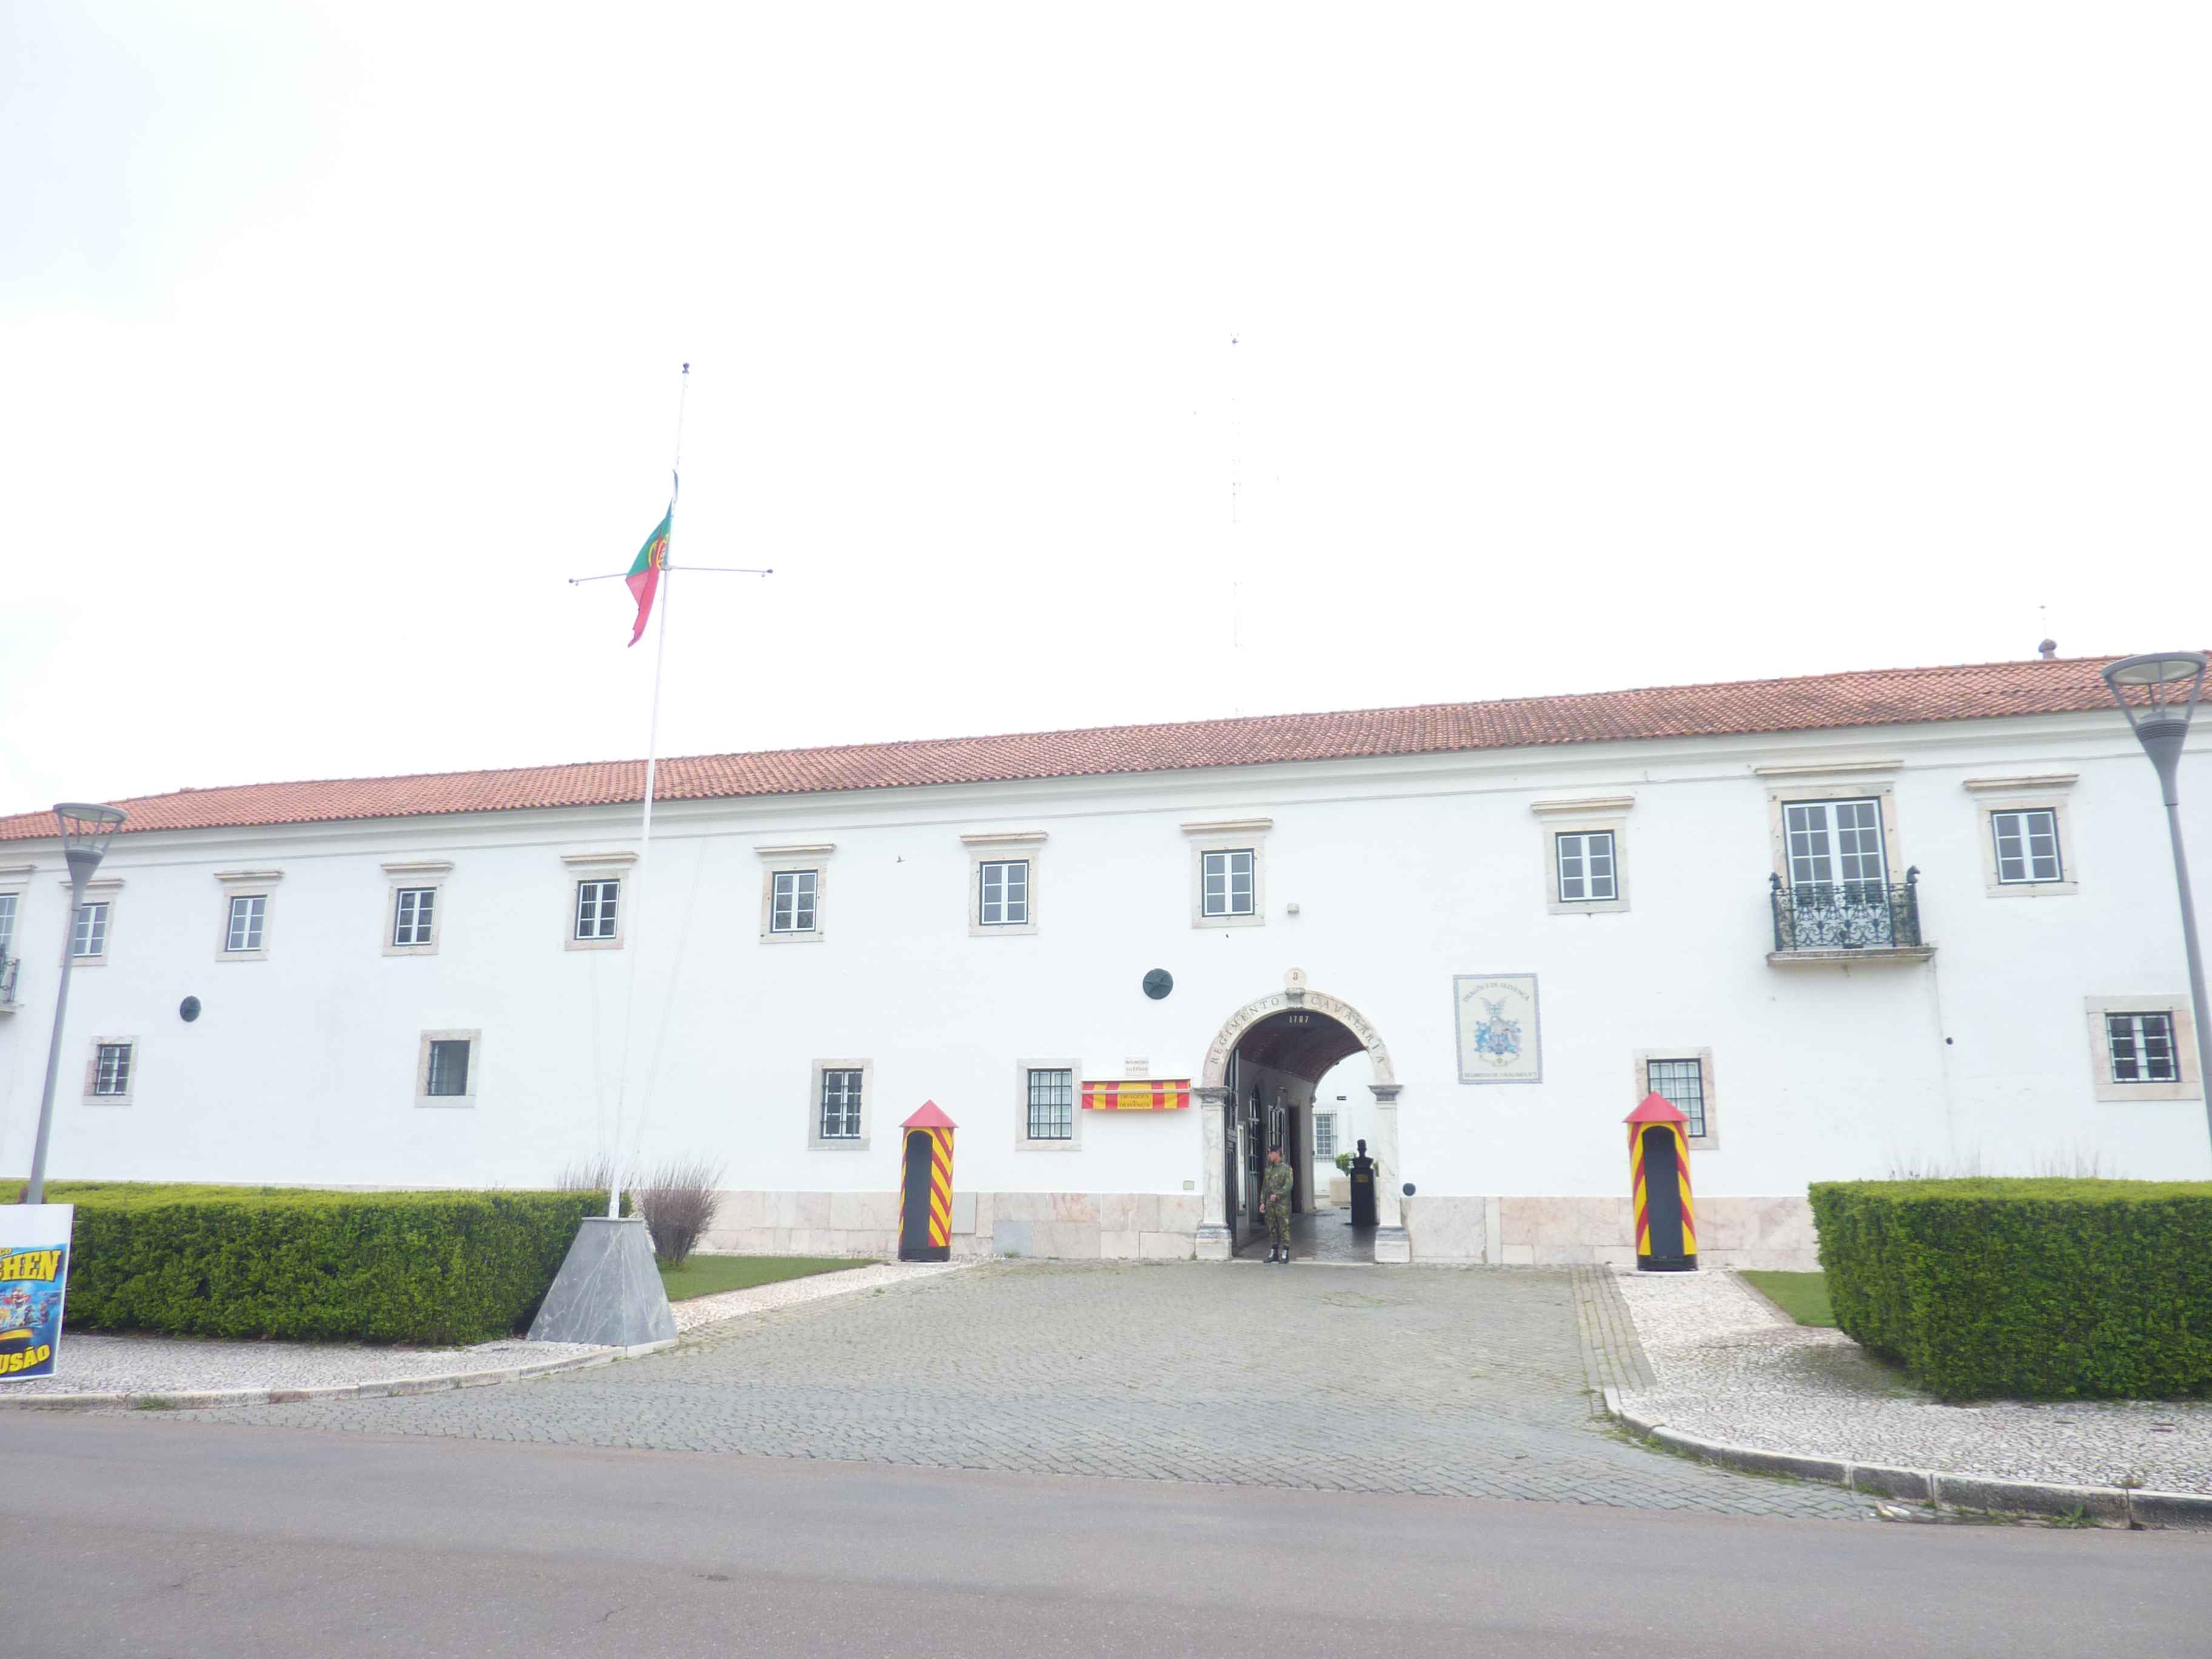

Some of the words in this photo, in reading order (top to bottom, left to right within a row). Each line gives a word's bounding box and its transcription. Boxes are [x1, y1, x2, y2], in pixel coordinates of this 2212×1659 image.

[1292, 971, 1299, 980] 3
[1210, 997, 1279, 1064] REGIMENTO
[1310, 996, 1385, 1064] CAVALARIA
